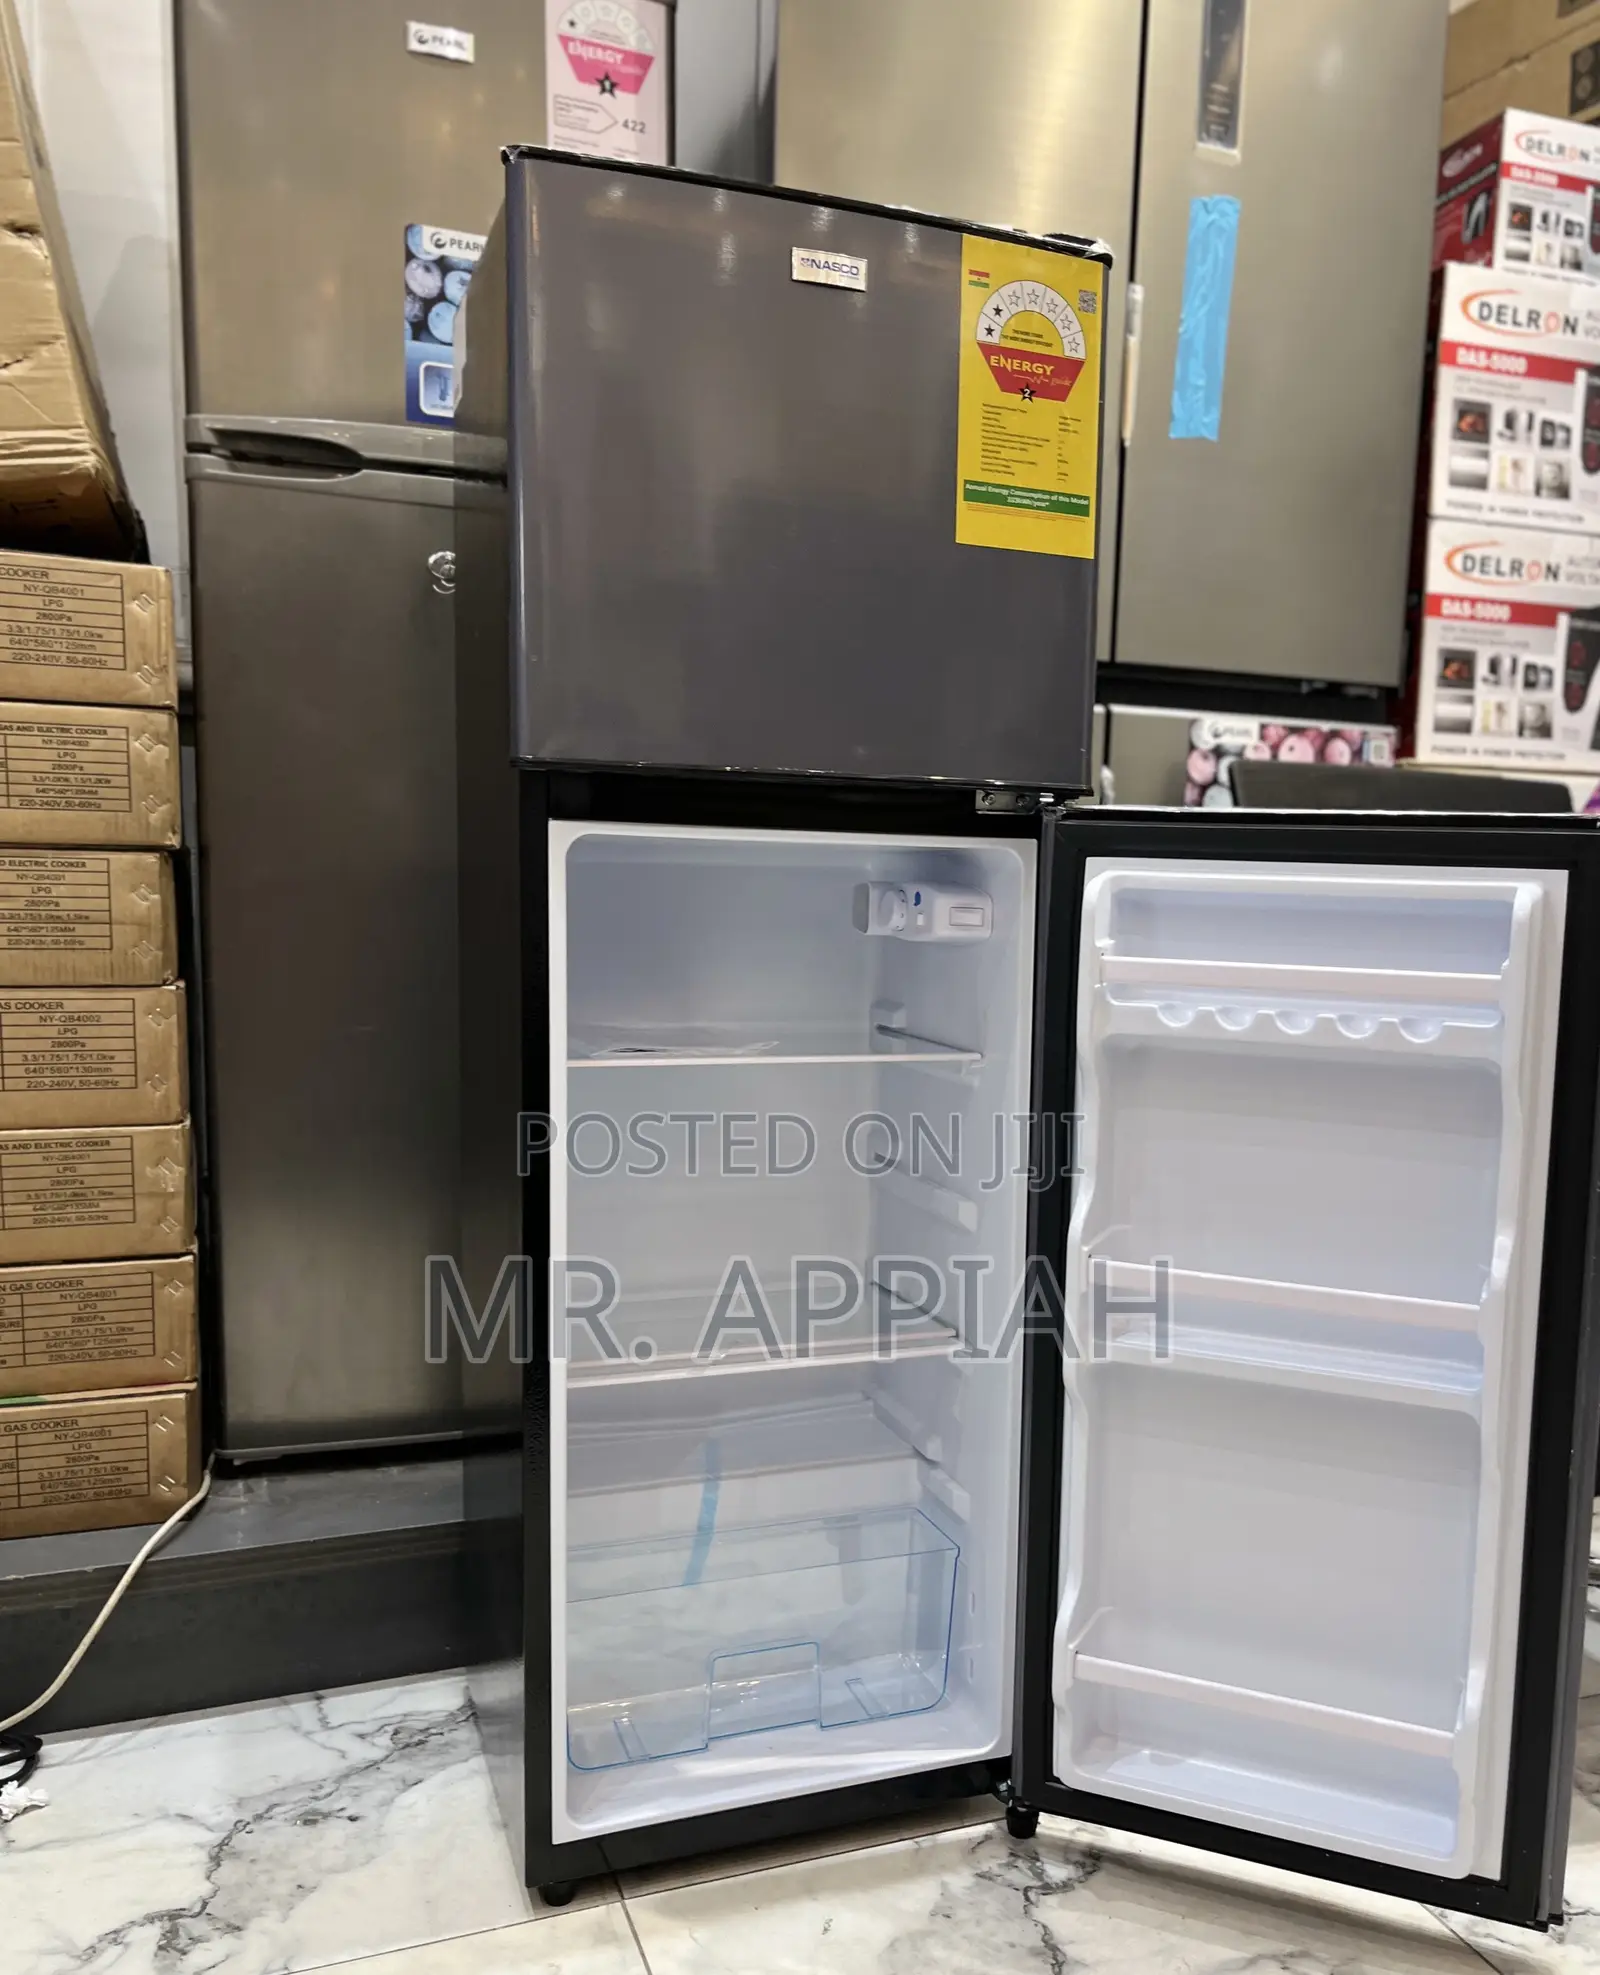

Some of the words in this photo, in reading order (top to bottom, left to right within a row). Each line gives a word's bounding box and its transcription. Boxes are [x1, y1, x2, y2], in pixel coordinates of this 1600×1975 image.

[568, 40, 625, 65] ENERGY
[622, 118, 646, 134] 422
[1526, 136, 1590, 162] DELRON
[811, 259, 859, 276] NASCO
[1478, 301, 1580, 335] DELRON
[990, 353, 1055, 376] ENERGY
[1023, 388, 1031, 398] 2
[965, 483, 987, 492] Annual
[988, 485, 1009, 496] Energy
[1010, 488, 1050, 500] Consumption
[1071, 497, 1089, 505] Model
[1462, 554, 1561, 581] DELRON
[0, 567, 49, 580] COOKER
[42, 599, 64, 608] LPG
[35, 612, 73, 622] 2800Pa
[16, 725, 35, 733] AND
[37, 726, 73, 735] ELECTRIC
[75, 727, 108, 736] COOKER
[57, 751, 77, 759] LPG
[8, 859, 48, 868] ELECTRIC
[50, 860, 87, 869] COOKER
[31, 886, 52, 894] LPG
[15, 1001, 64, 1010] COOKER
[39, 1014, 102, 1024] NY-QB4002
[57, 1027, 78, 1036] LPG
[50, 1040, 87, 1049] 2800Pa
[12, 1142, 32, 1150] AND
[34, 1141, 73, 1149] ELECTRIC
[75, 1139, 111, 1148] COOKER
[56, 1166, 77, 1174] LPG
[9, 1282, 33, 1292] GAS
[36, 1280, 84, 1290] COOKER
[77, 1303, 98, 1312] LPG
[4, 1423, 28, 1433] GAS
[30, 1419, 79, 1431] COOKER
[72, 1442, 93, 1452] LPG
